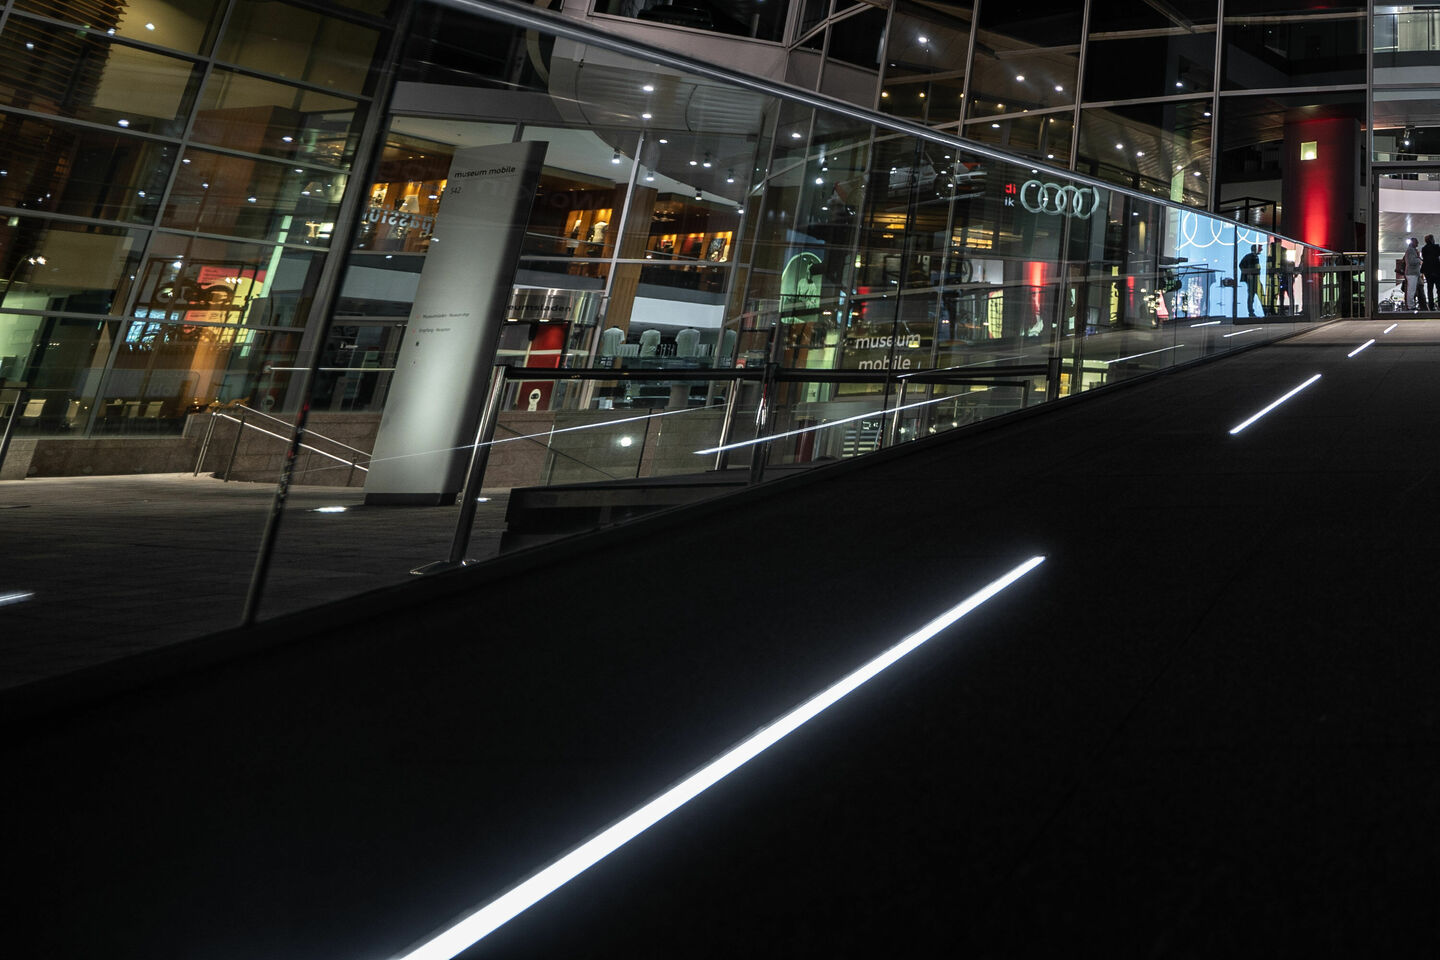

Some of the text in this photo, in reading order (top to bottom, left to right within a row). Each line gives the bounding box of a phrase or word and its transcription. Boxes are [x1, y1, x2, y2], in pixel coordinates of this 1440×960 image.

[454, 166, 516, 178] museum mobile
[855, 334, 921, 350] museum
[858, 355, 911, 370] mobile
